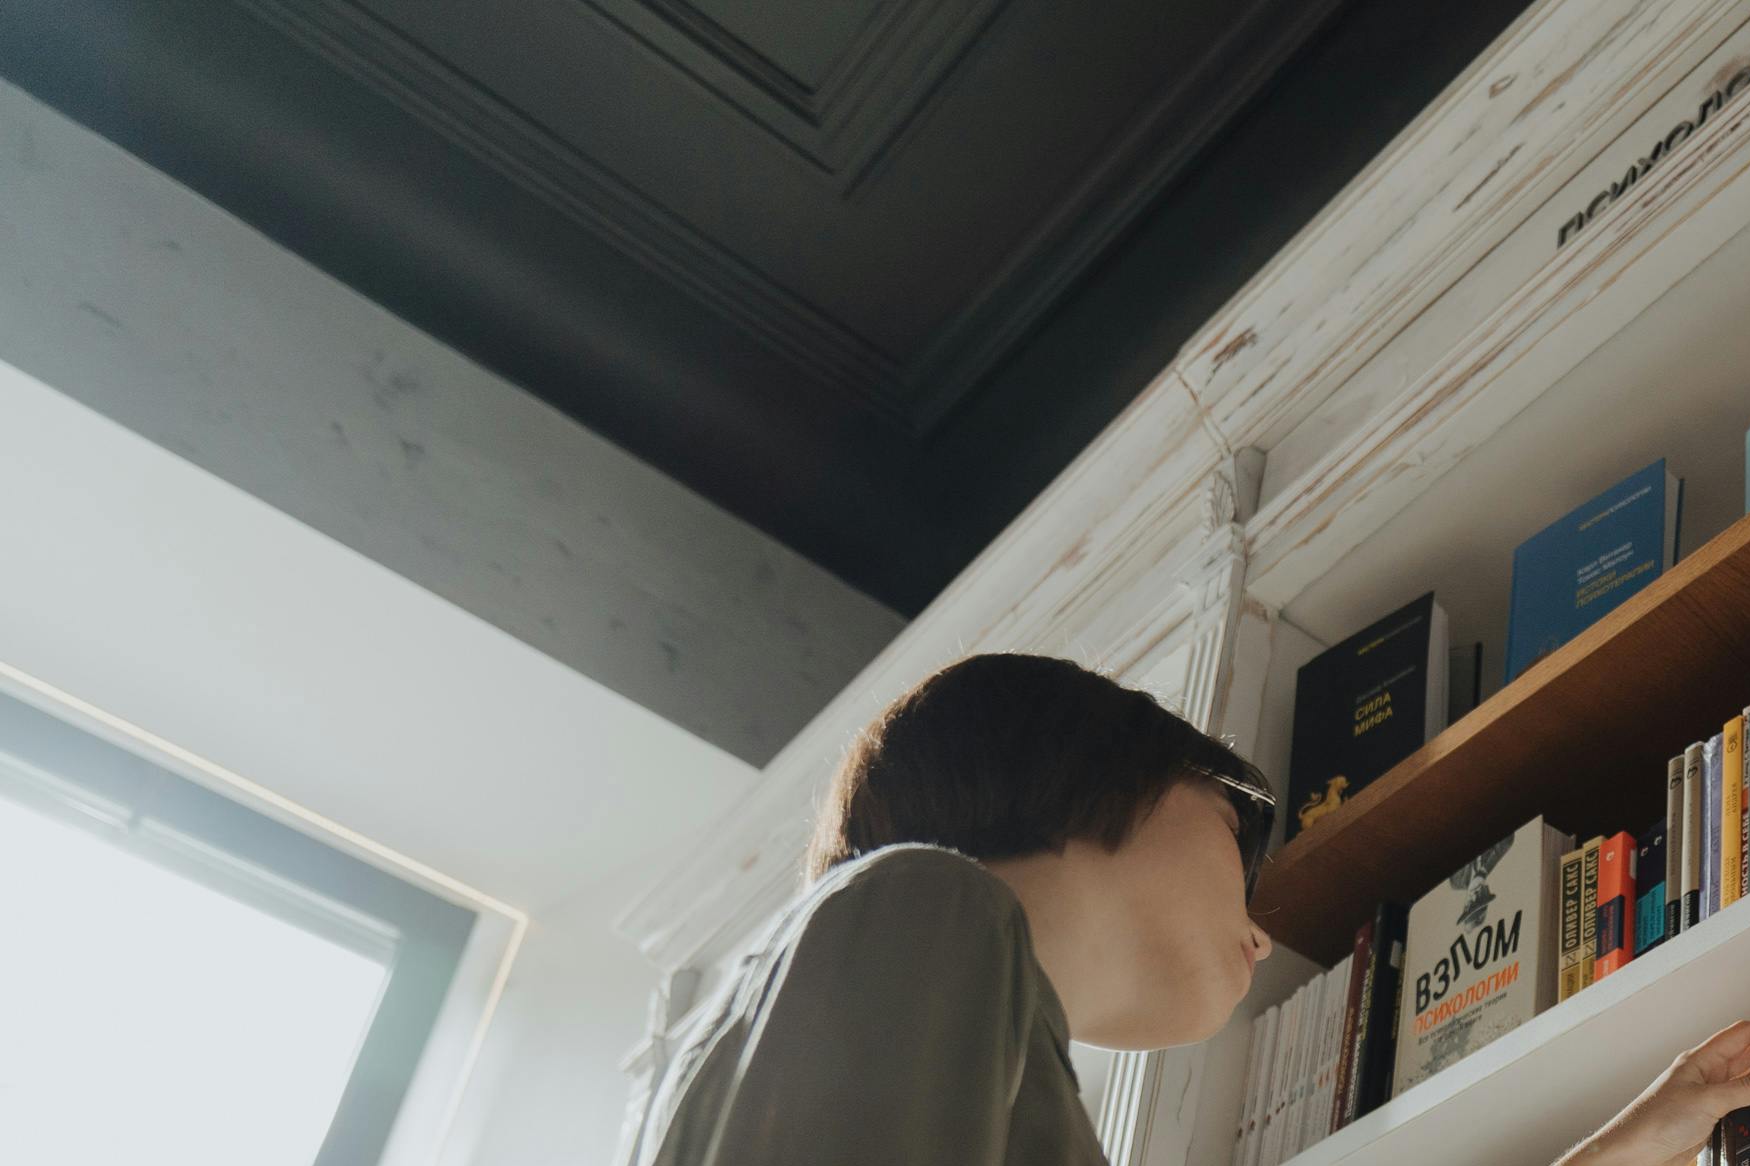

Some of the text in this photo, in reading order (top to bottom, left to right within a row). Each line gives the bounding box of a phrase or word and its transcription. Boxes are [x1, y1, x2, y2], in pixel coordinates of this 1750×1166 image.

[1353, 706, 1392, 737] МИФА
[1355, 691, 1391, 721] СИЛА
[1565, 862, 1579, 949] ОЛИВЕР САКС
[1583, 851, 1598, 938] ОЛИВЕР САКС
[1415, 910, 1523, 1017] ВЗЛОМ
[1415, 961, 1519, 1035] ПСИХОЛОГИИ
